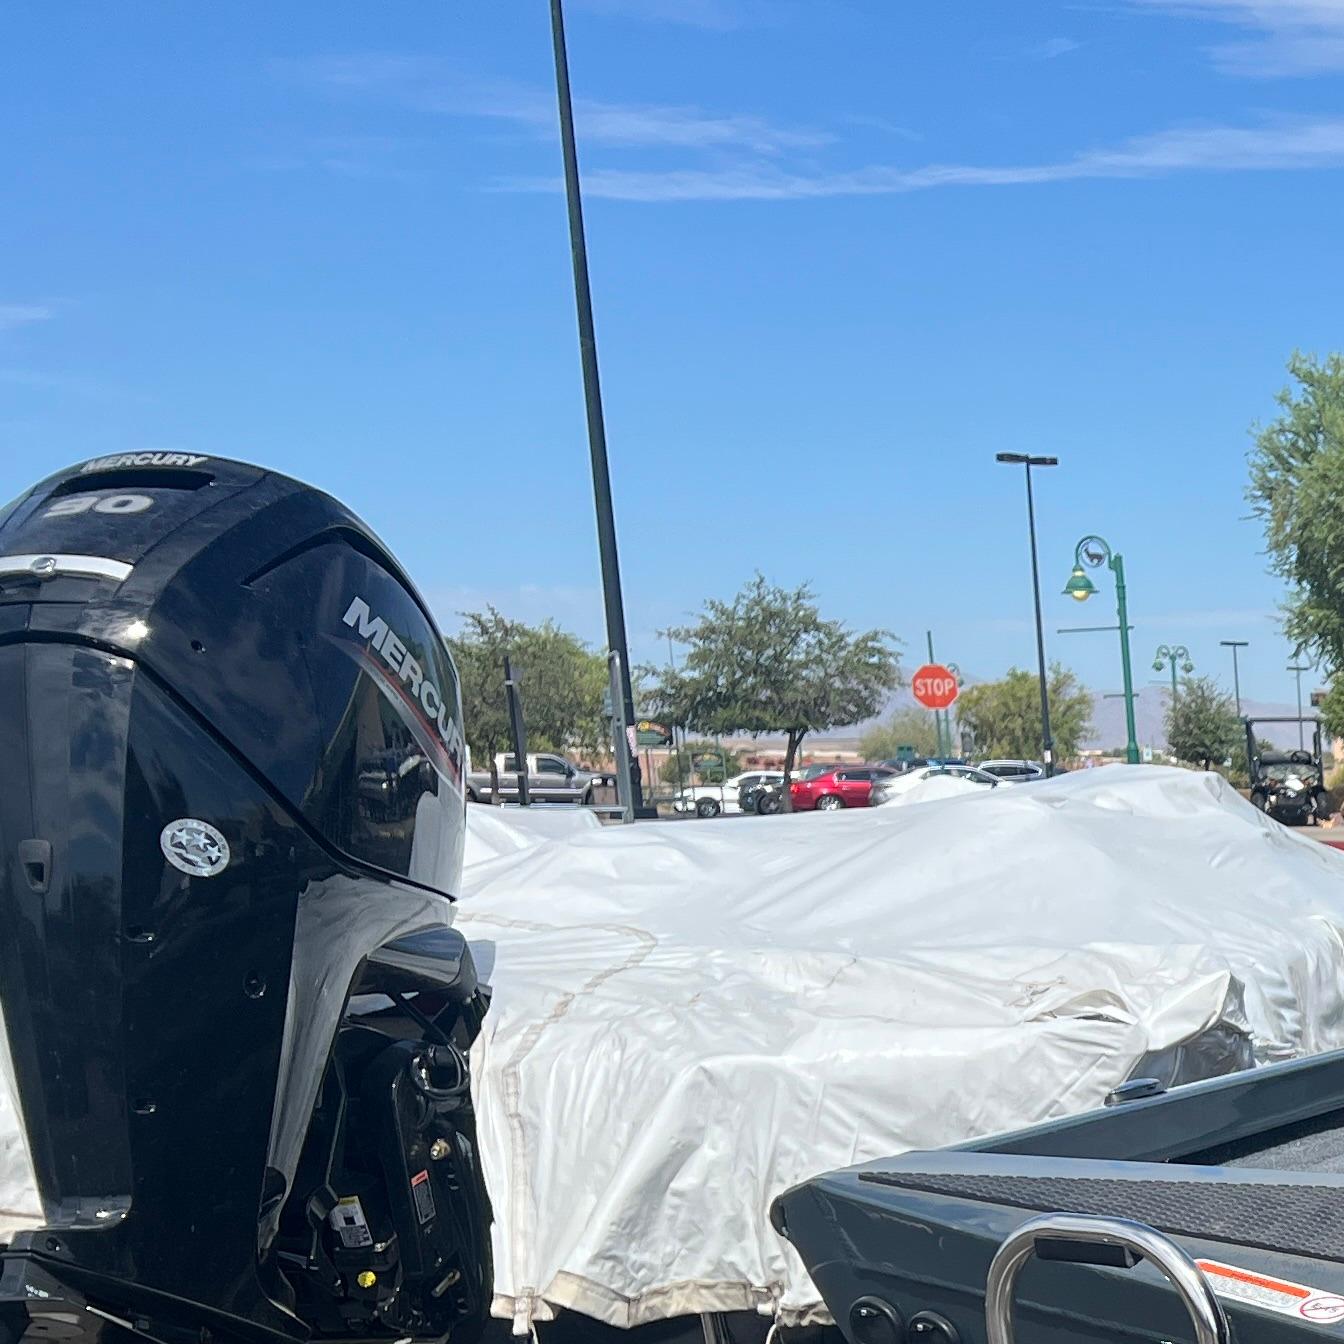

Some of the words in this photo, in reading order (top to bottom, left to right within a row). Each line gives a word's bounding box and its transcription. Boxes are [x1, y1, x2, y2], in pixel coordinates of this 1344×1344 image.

[80, 453, 208, 473] MERCURY
[43, 494, 153, 517] 90
[342, 596, 463, 769] MERCUR
[915, 678, 954, 696] STOP
